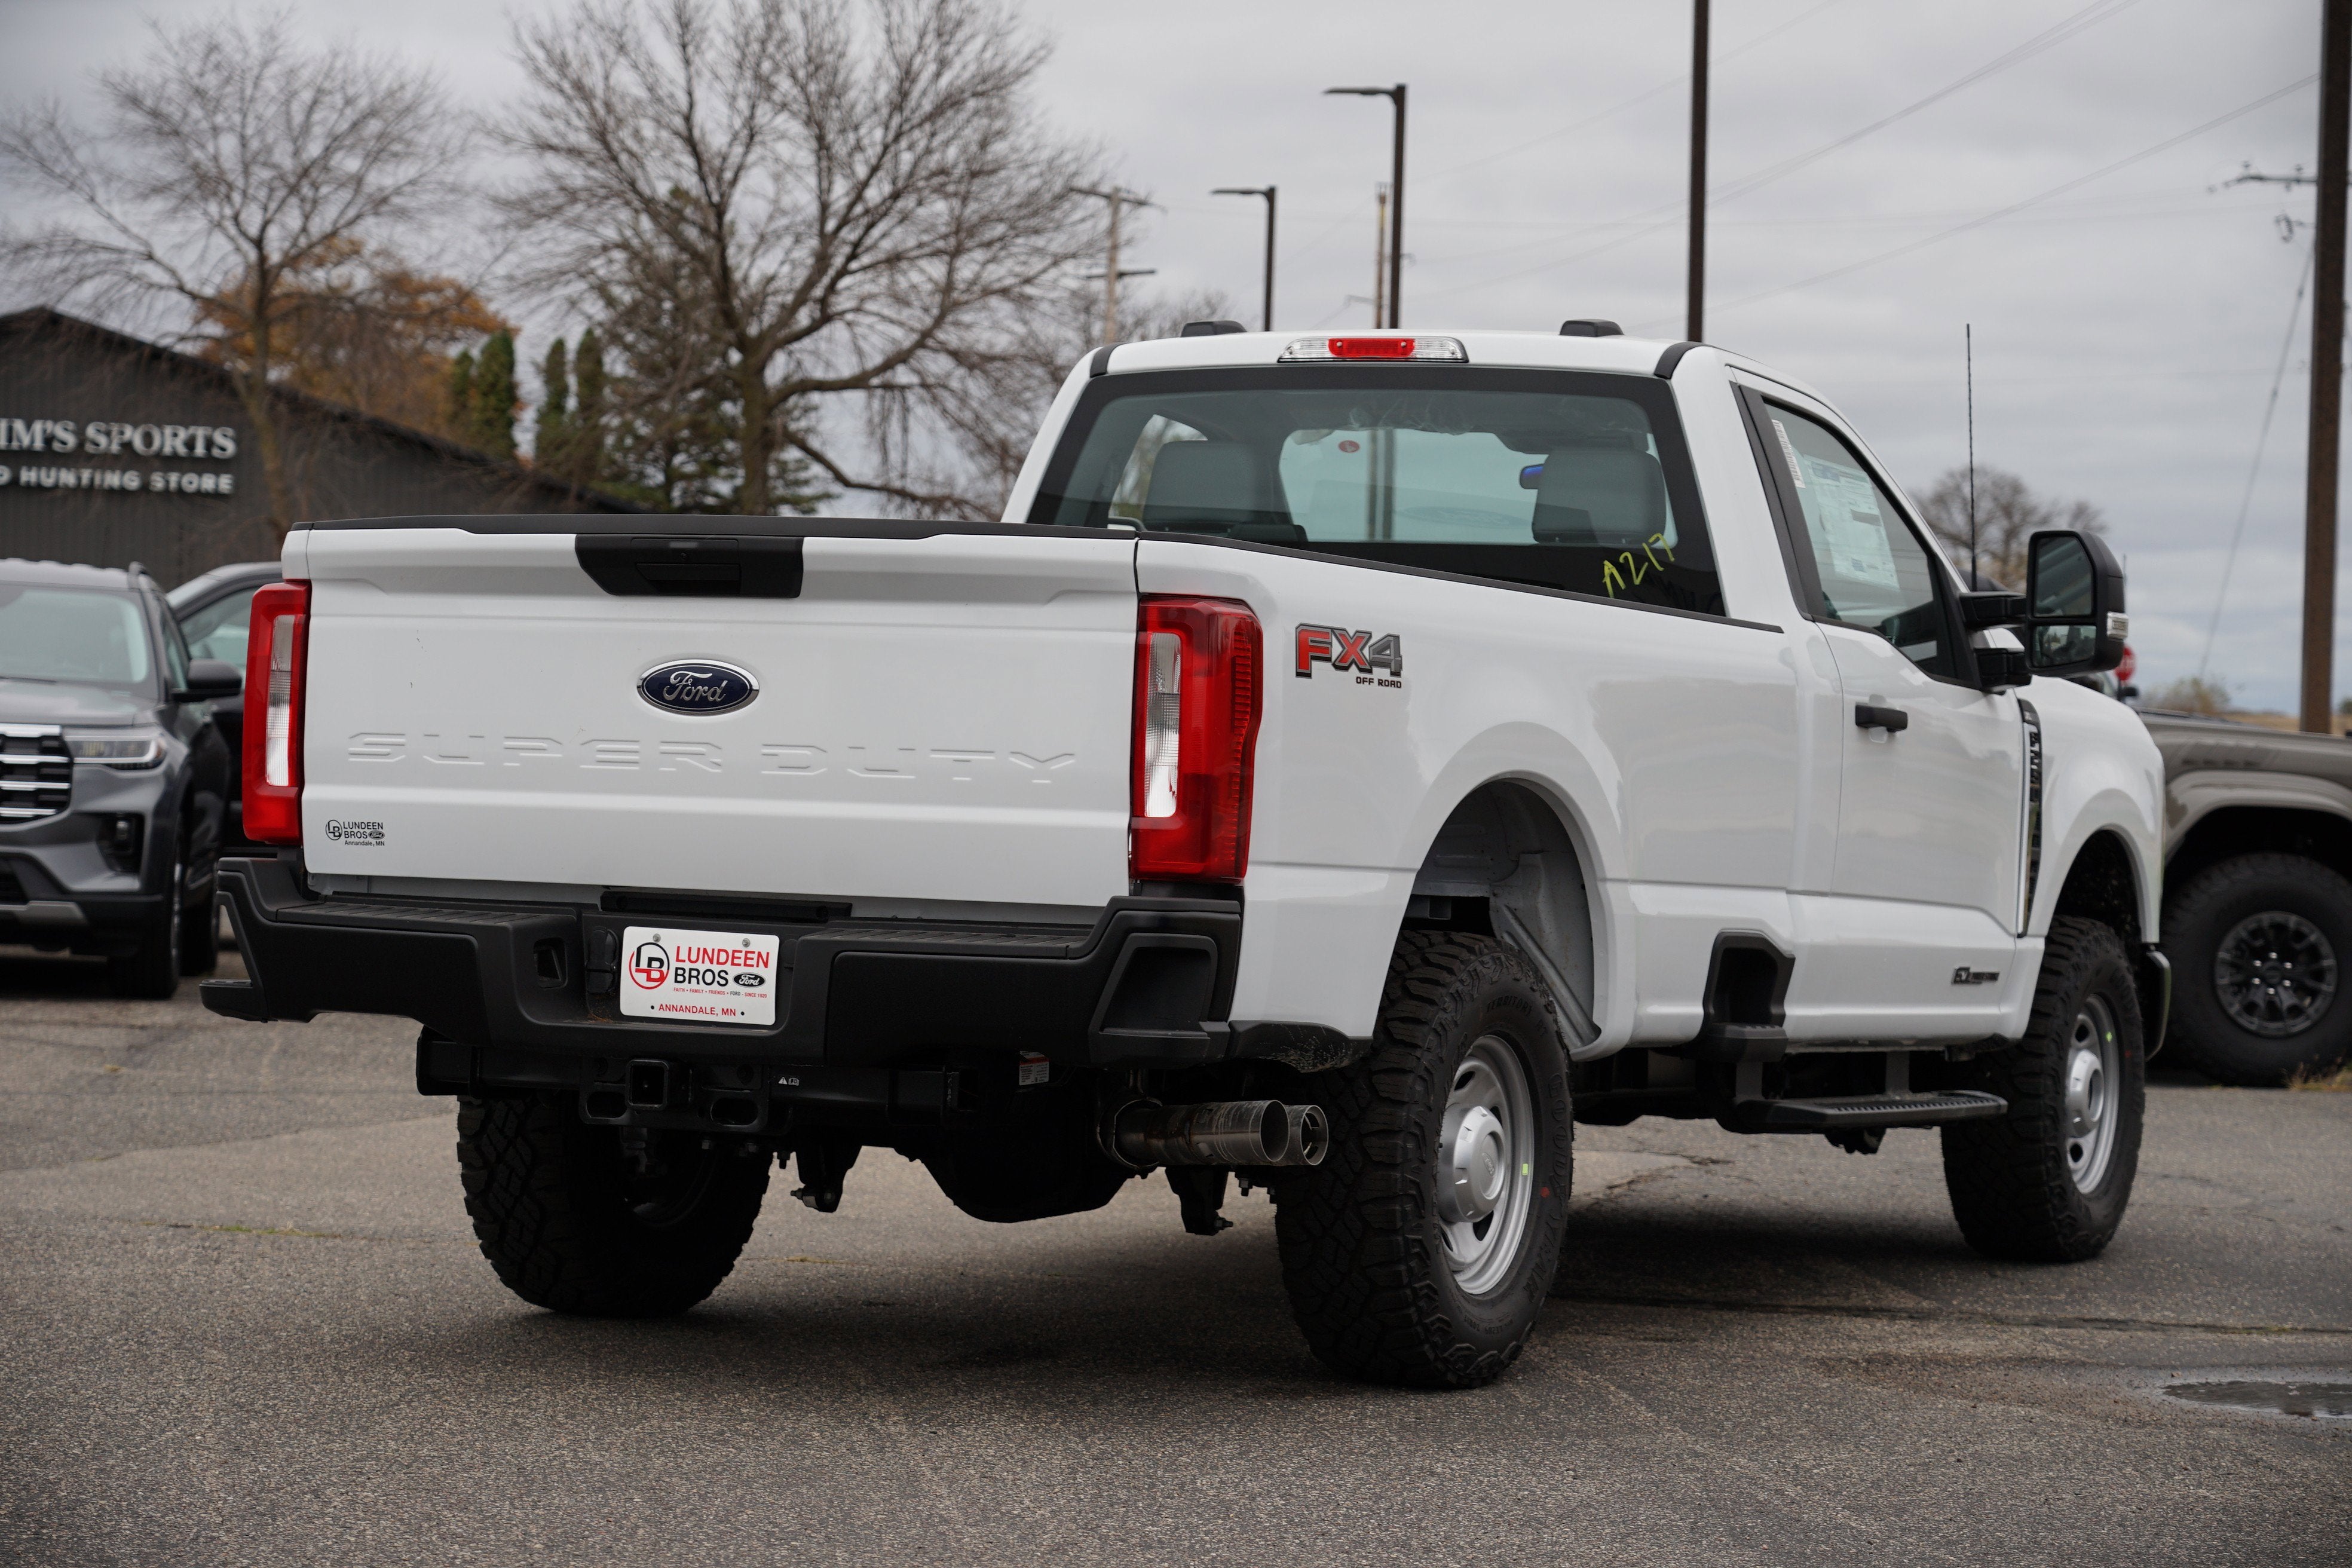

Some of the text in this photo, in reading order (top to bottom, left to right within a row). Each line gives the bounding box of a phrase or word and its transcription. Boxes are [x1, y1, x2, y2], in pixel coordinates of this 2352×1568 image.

[84, 422, 237, 459] SPORTS
[19, 466, 142, 491] HUNTING
[148, 471, 234, 495] STORE
[1602, 532, 1675, 598] A217
[1296, 623, 1402, 678] FX4
[663, 670, 728, 702] Ford
[1356, 676, 1402, 688] OFF ROAD
[348, 732, 1075, 783] SUPER DUTY
[342, 822, 383, 830] LUNDEEN
[676, 946, 769, 968] LUNDEEN
[674, 967, 760, 987] BROS Ford
[659, 1003, 736, 1016] ANNANDALE, MN
